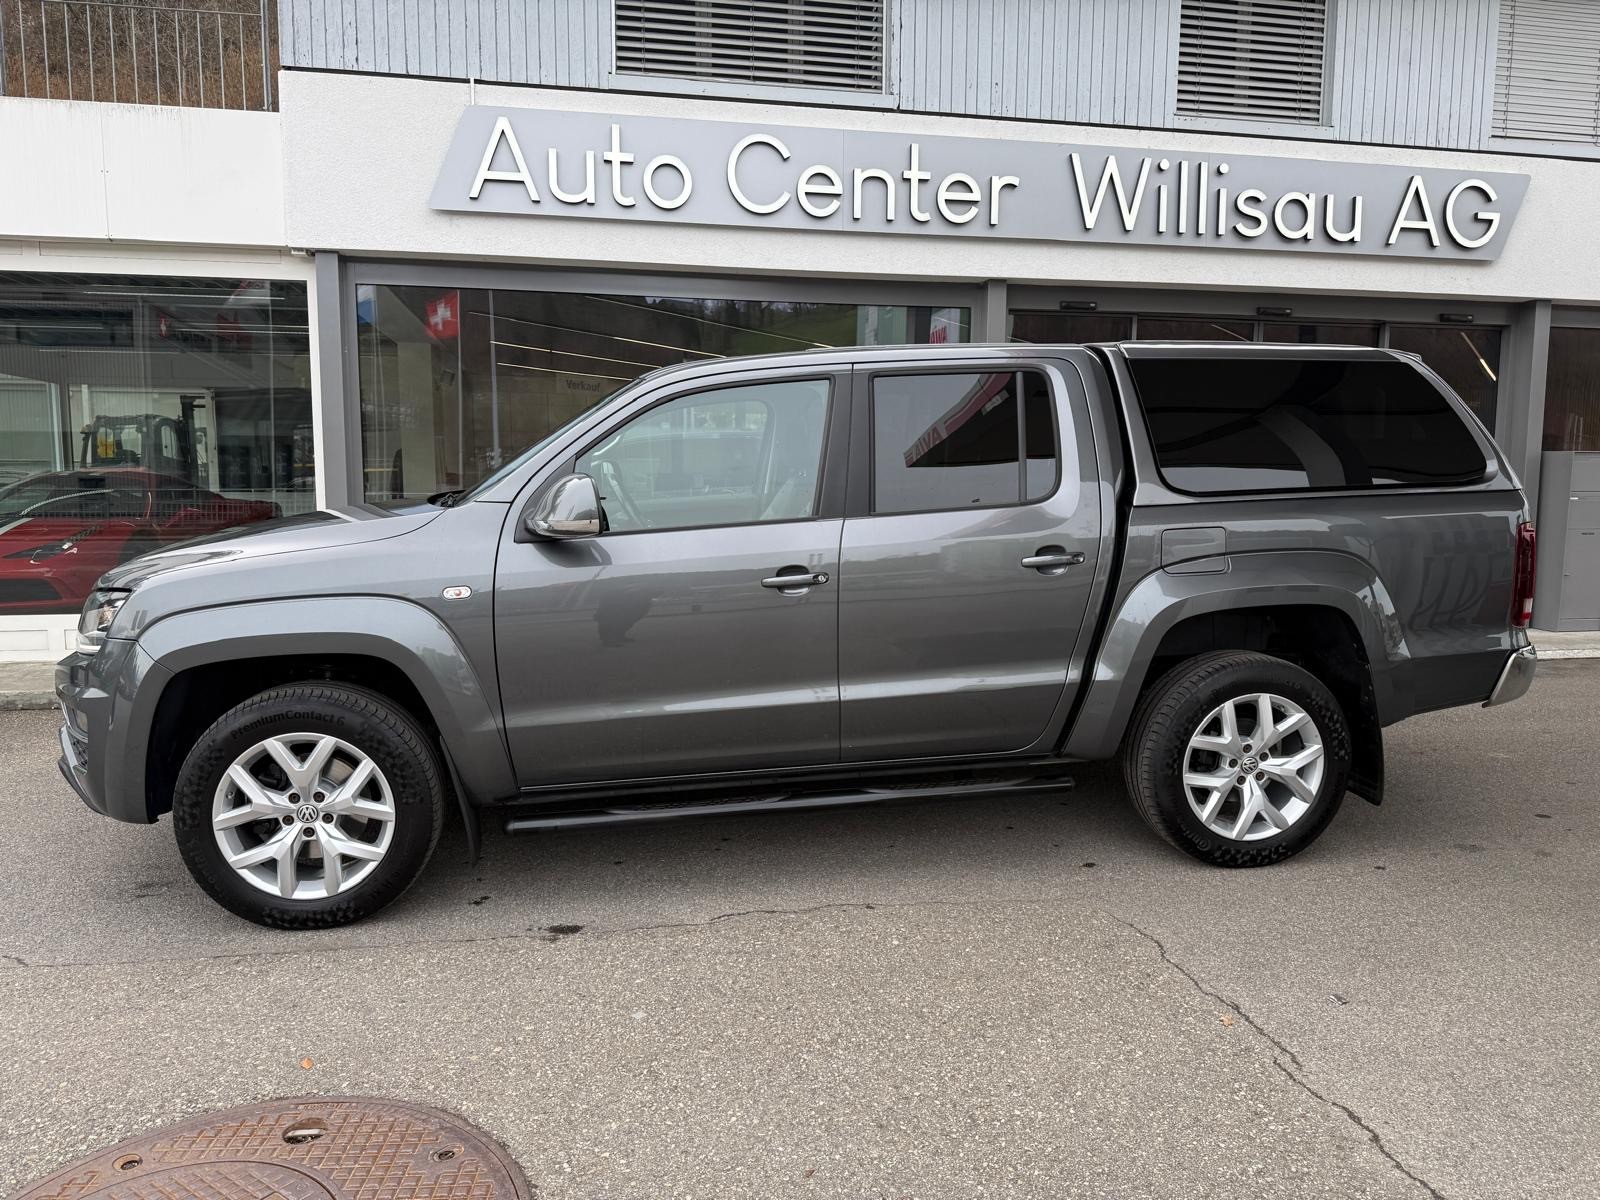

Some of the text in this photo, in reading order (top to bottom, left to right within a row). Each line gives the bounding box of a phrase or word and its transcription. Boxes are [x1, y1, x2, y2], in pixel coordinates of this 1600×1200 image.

[469, 116, 1501, 249] Auto Center Willisau AG
[566, 379, 601, 393] Verkauf
[230, 709, 346, 740] PremiumContact 6
